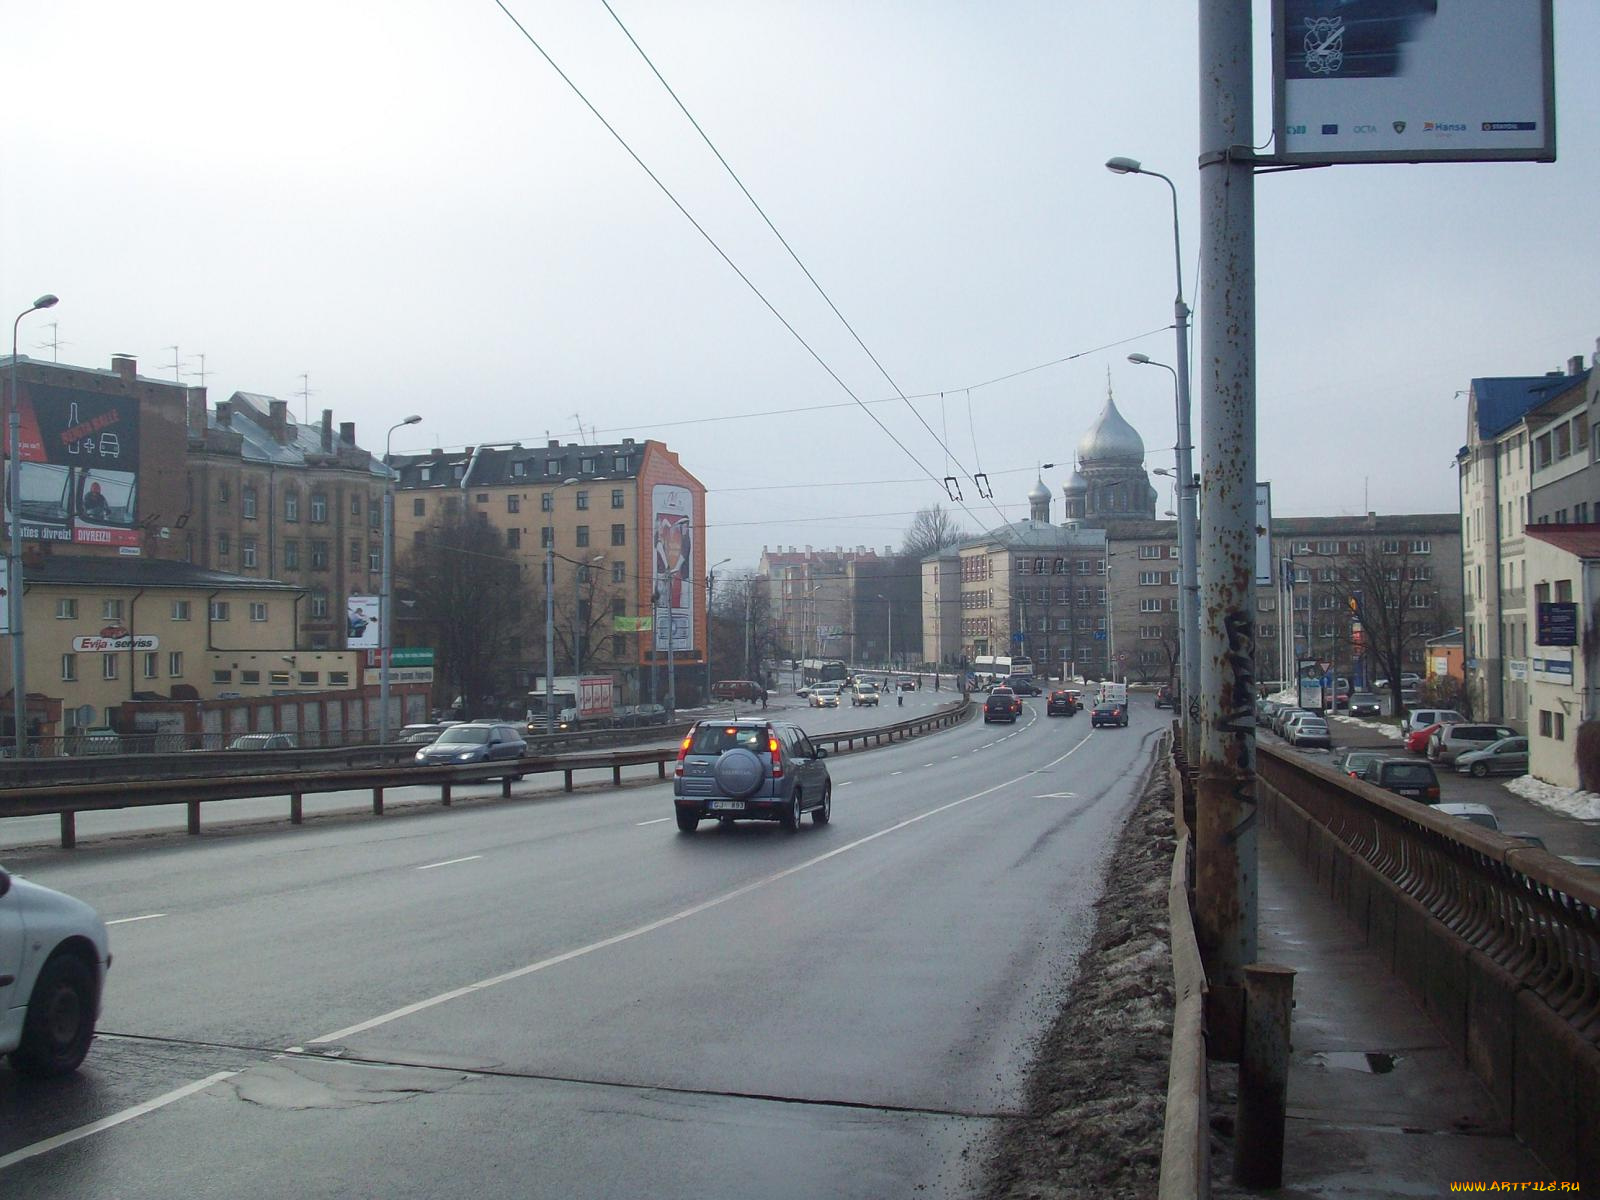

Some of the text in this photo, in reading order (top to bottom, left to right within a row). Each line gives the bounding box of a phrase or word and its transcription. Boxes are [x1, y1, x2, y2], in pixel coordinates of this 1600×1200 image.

[1435, 122, 1467, 131] Hansa
[42, 527, 72, 541] divreiz!
[81, 638, 153, 650] Evija serviss
